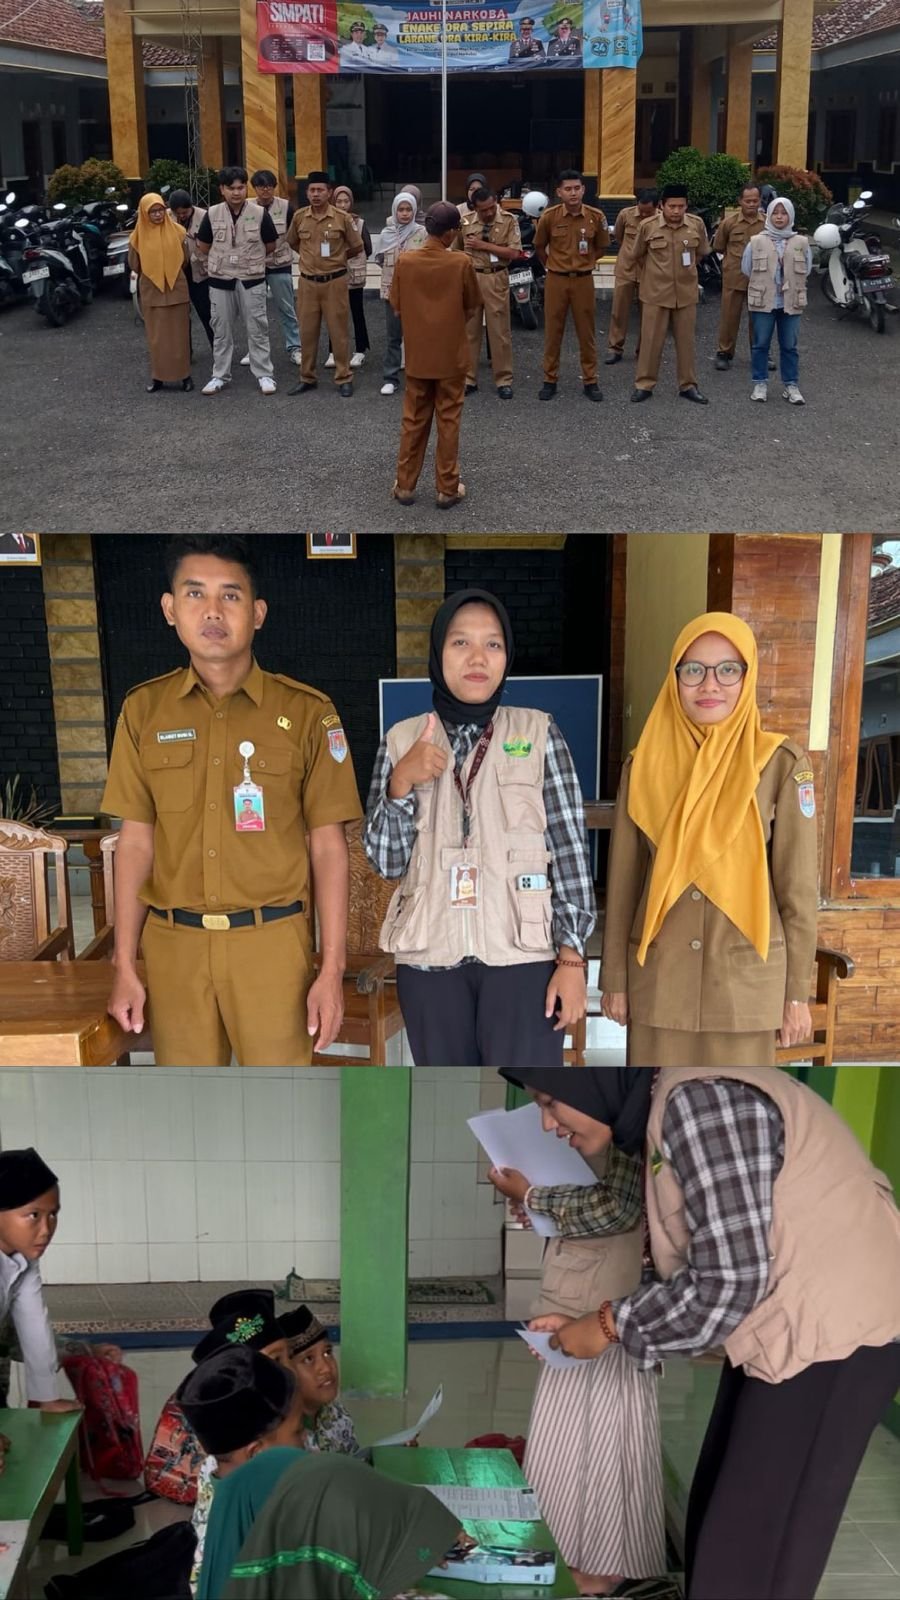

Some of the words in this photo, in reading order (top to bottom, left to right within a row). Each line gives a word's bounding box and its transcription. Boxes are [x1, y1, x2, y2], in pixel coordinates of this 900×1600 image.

[269, 2, 325, 24] SIMPATI
[406, 11, 442, 21] JAUHI
[445, 9, 505, 20] NARKOBA
[402, 22, 441, 33] ENAKE
[445, 22, 468, 32] ORA
[471, 21, 514, 31] SEPIRA
[399, 34, 438, 44] LARANE
[464, 32, 517, 42] KIRA-KIRA
